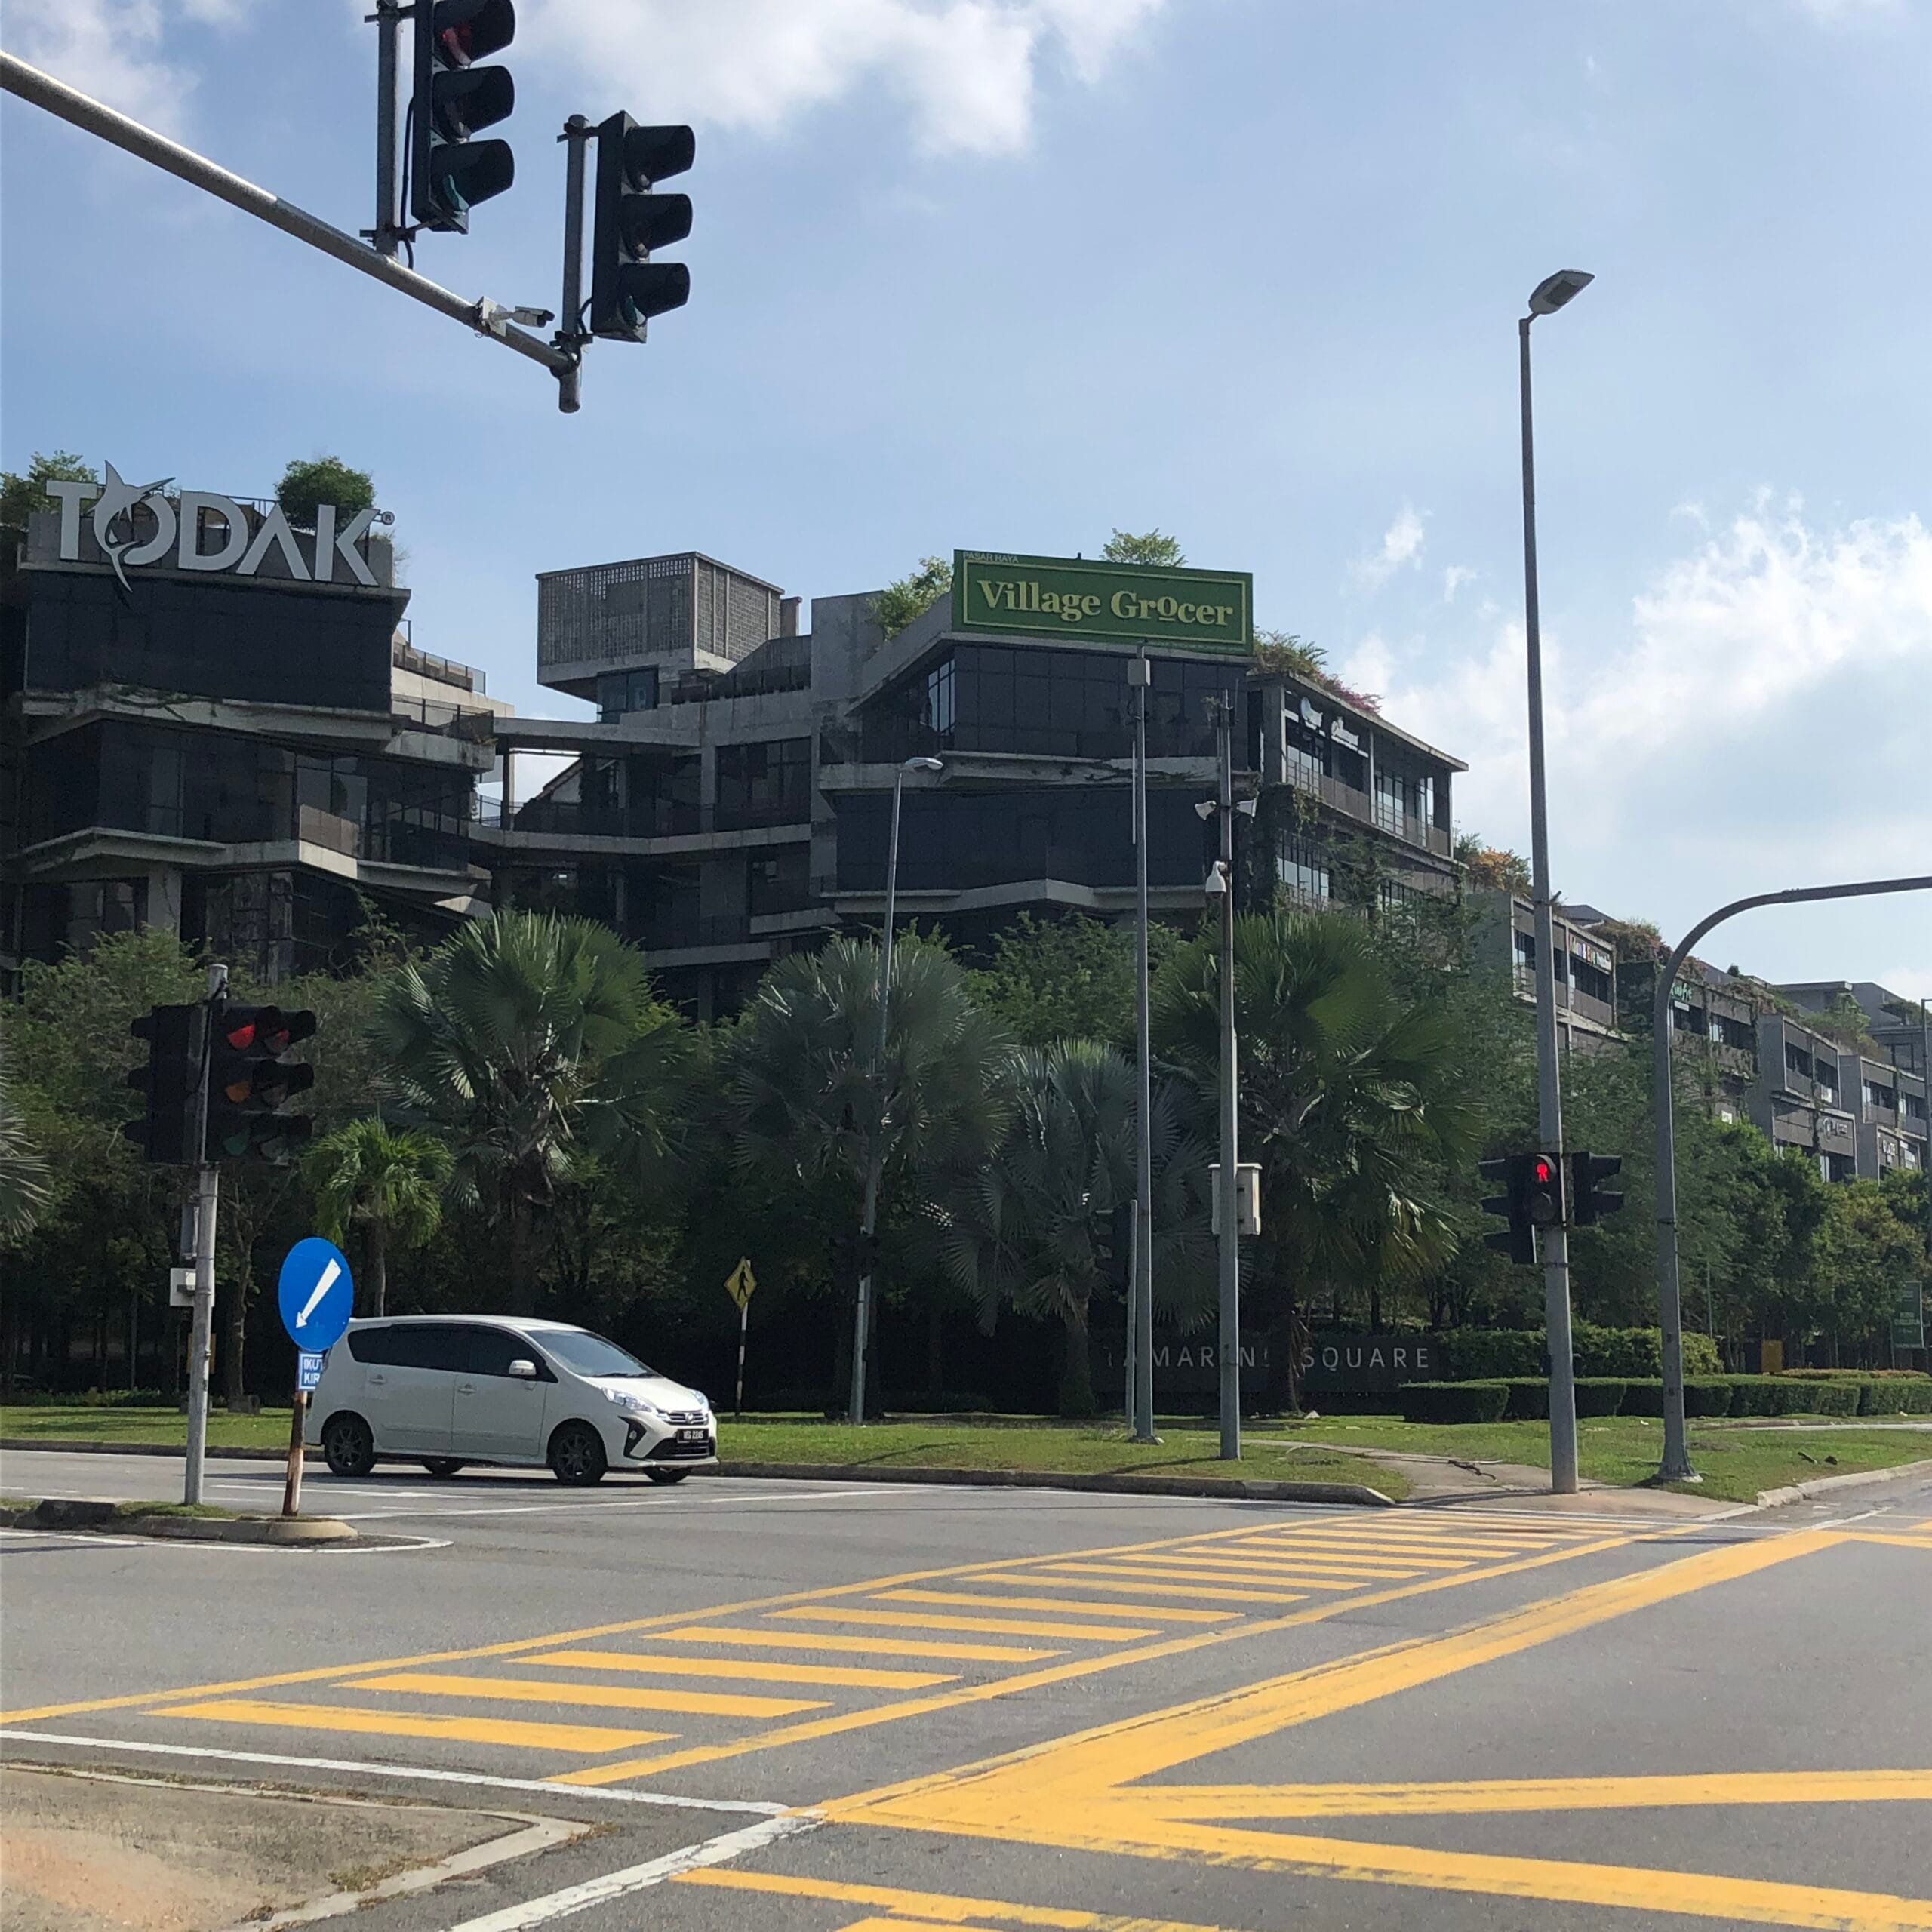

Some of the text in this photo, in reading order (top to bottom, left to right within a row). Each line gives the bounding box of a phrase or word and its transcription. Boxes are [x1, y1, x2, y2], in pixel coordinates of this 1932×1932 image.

[47, 461, 379, 591] TODAK
[963, 551, 1019, 563] PASAR RAYA
[977, 580, 1233, 626] Village Grocer
[1302, 1346, 1429, 1371] SQUARE
